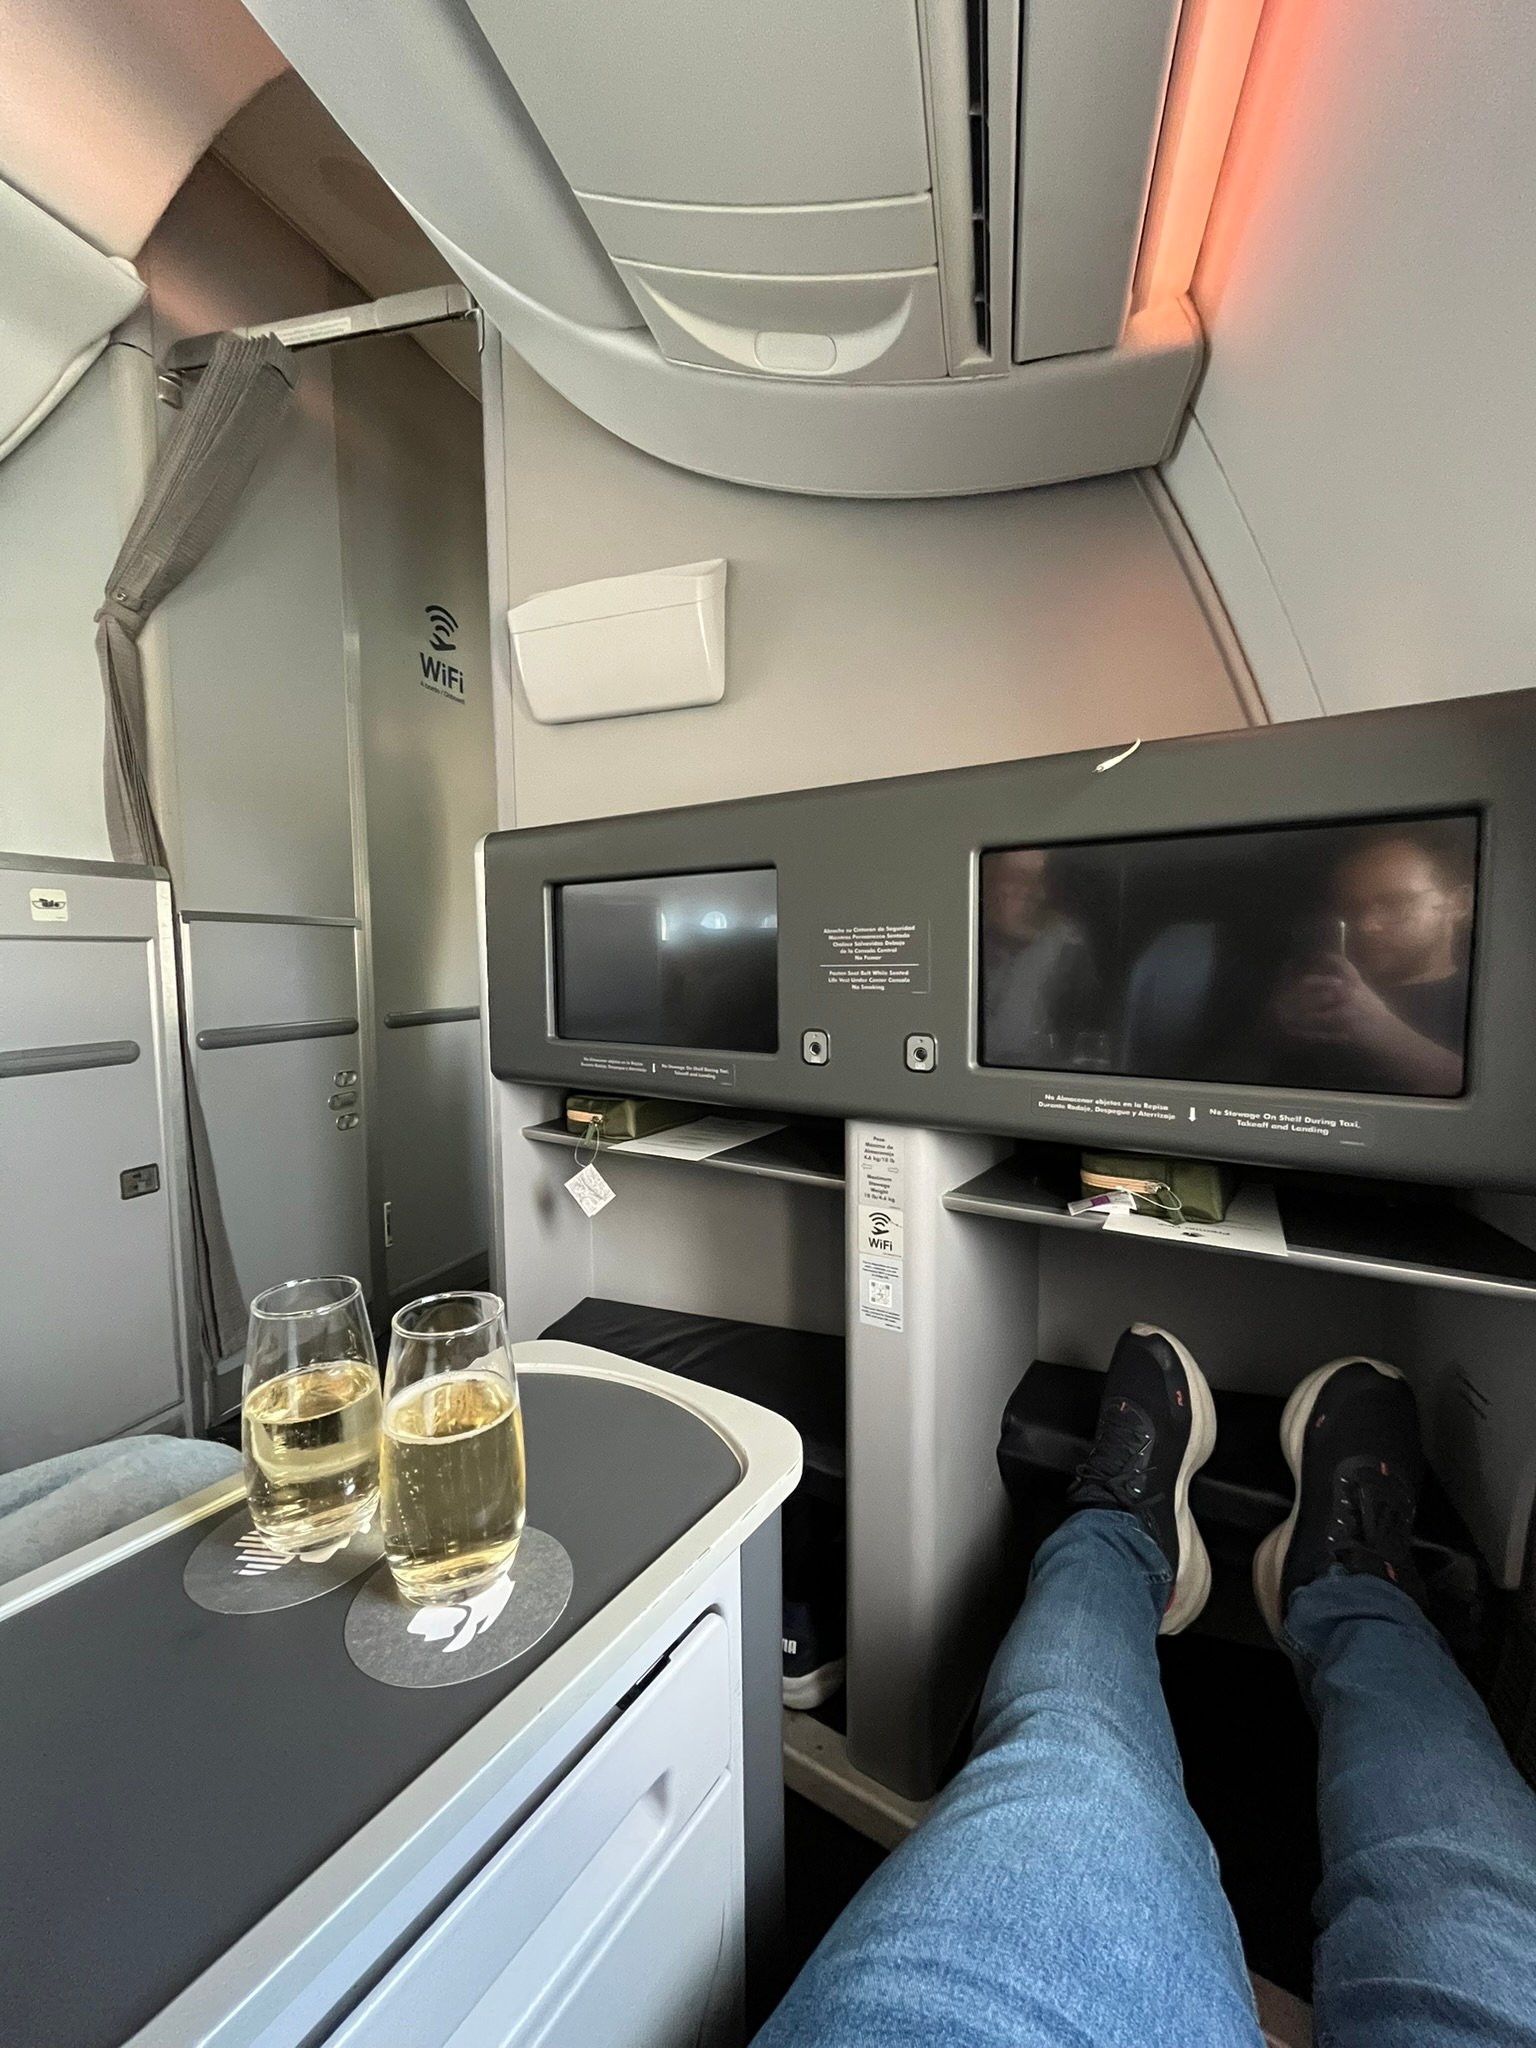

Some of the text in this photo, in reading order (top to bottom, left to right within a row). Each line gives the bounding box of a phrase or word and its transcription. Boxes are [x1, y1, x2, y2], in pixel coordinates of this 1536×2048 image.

[419, 652, 464, 693] WiFi
[1038, 1101, 1066, 1110] Durante
[1095, 1106, 1131, 1116] Despegue
[1138, 1110, 1176, 1121] Aterrizaje
[1056, 1095, 1093, 1104] Almacenar
[1095, 1099, 1121, 1107] objetos
[1143, 1103, 1169, 1111] Repisa
[1209, 1108, 1222, 1116] No
[1224, 1109, 1260, 1120] Stowage
[1263, 1113, 1277, 1121] On
[1279, 1114, 1302, 1123] Shelf
[1304, 1116, 1337, 1127] During
[1237, 1119, 1329, 1136] Takeoff and Landing
[868, 1237, 893, 1251] WiFi
